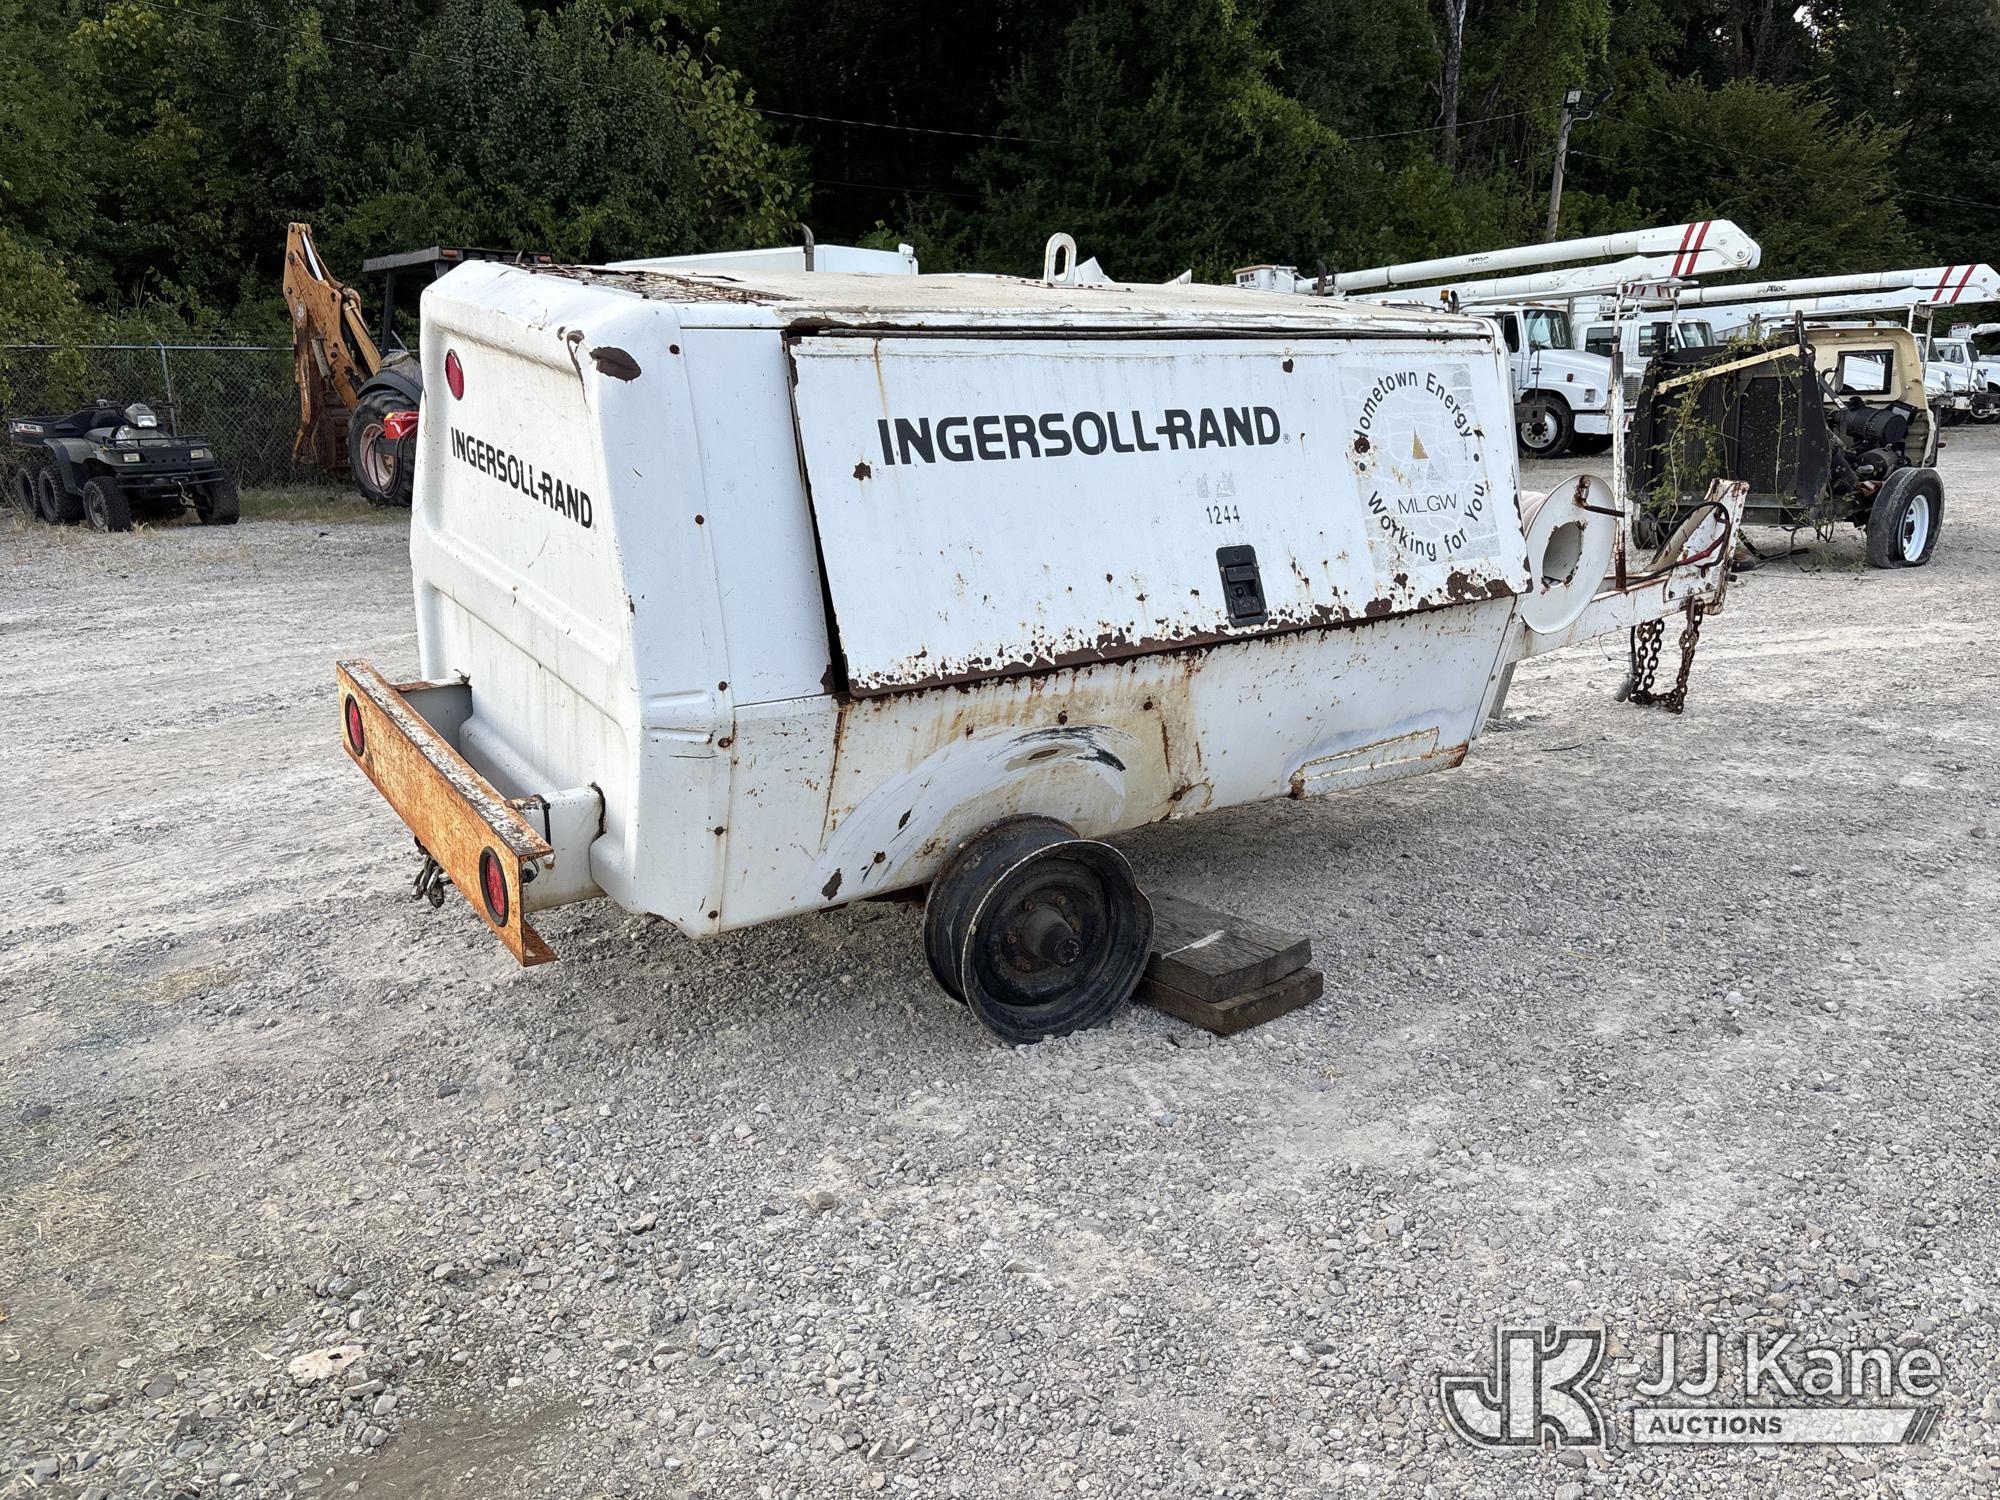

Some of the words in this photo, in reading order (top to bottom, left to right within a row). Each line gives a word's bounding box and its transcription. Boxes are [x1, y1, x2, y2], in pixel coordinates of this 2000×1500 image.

[877, 406, 1281, 466] INGERSOLL-RAND
[1426, 372, 1473, 438] Energy
[450, 427, 593, 529] INGERSOLL-RAND
[1398, 493, 1457, 514] MLGW
[1206, 504, 1240, 524] 1244
[1368, 491, 1437, 562] Working
[1444, 527, 1468, 553] for
[1464, 483, 1485, 522] You
